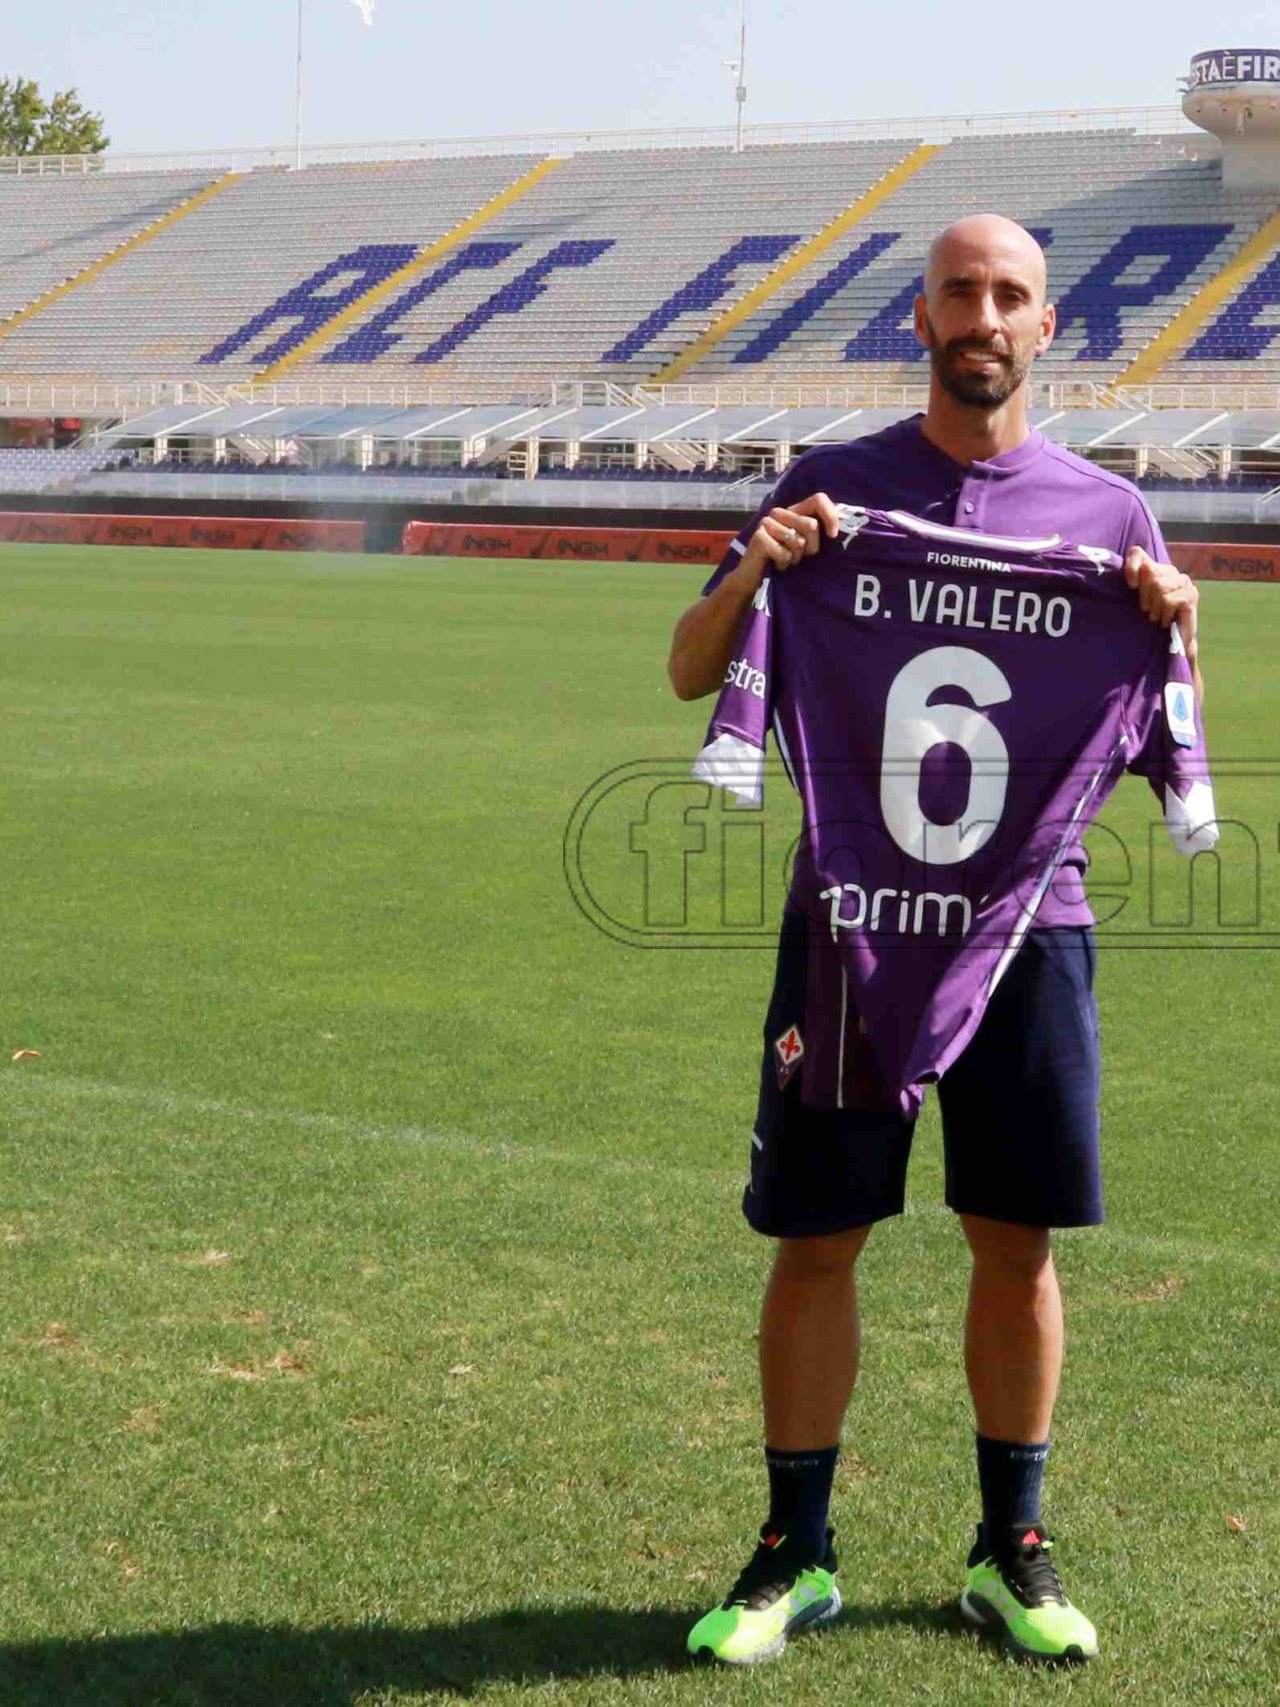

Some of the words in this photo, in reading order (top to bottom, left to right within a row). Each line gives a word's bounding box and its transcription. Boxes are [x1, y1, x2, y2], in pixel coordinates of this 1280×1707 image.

[926, 551, 1012, 573] FIORENTINA
[1215, 556, 1274, 575] NGM
[853, 573, 893, 620] B.
[908, 578, 1072, 638] VALERO
[880, 645, 1013, 865] 6
[819, 883, 973, 943] prim
